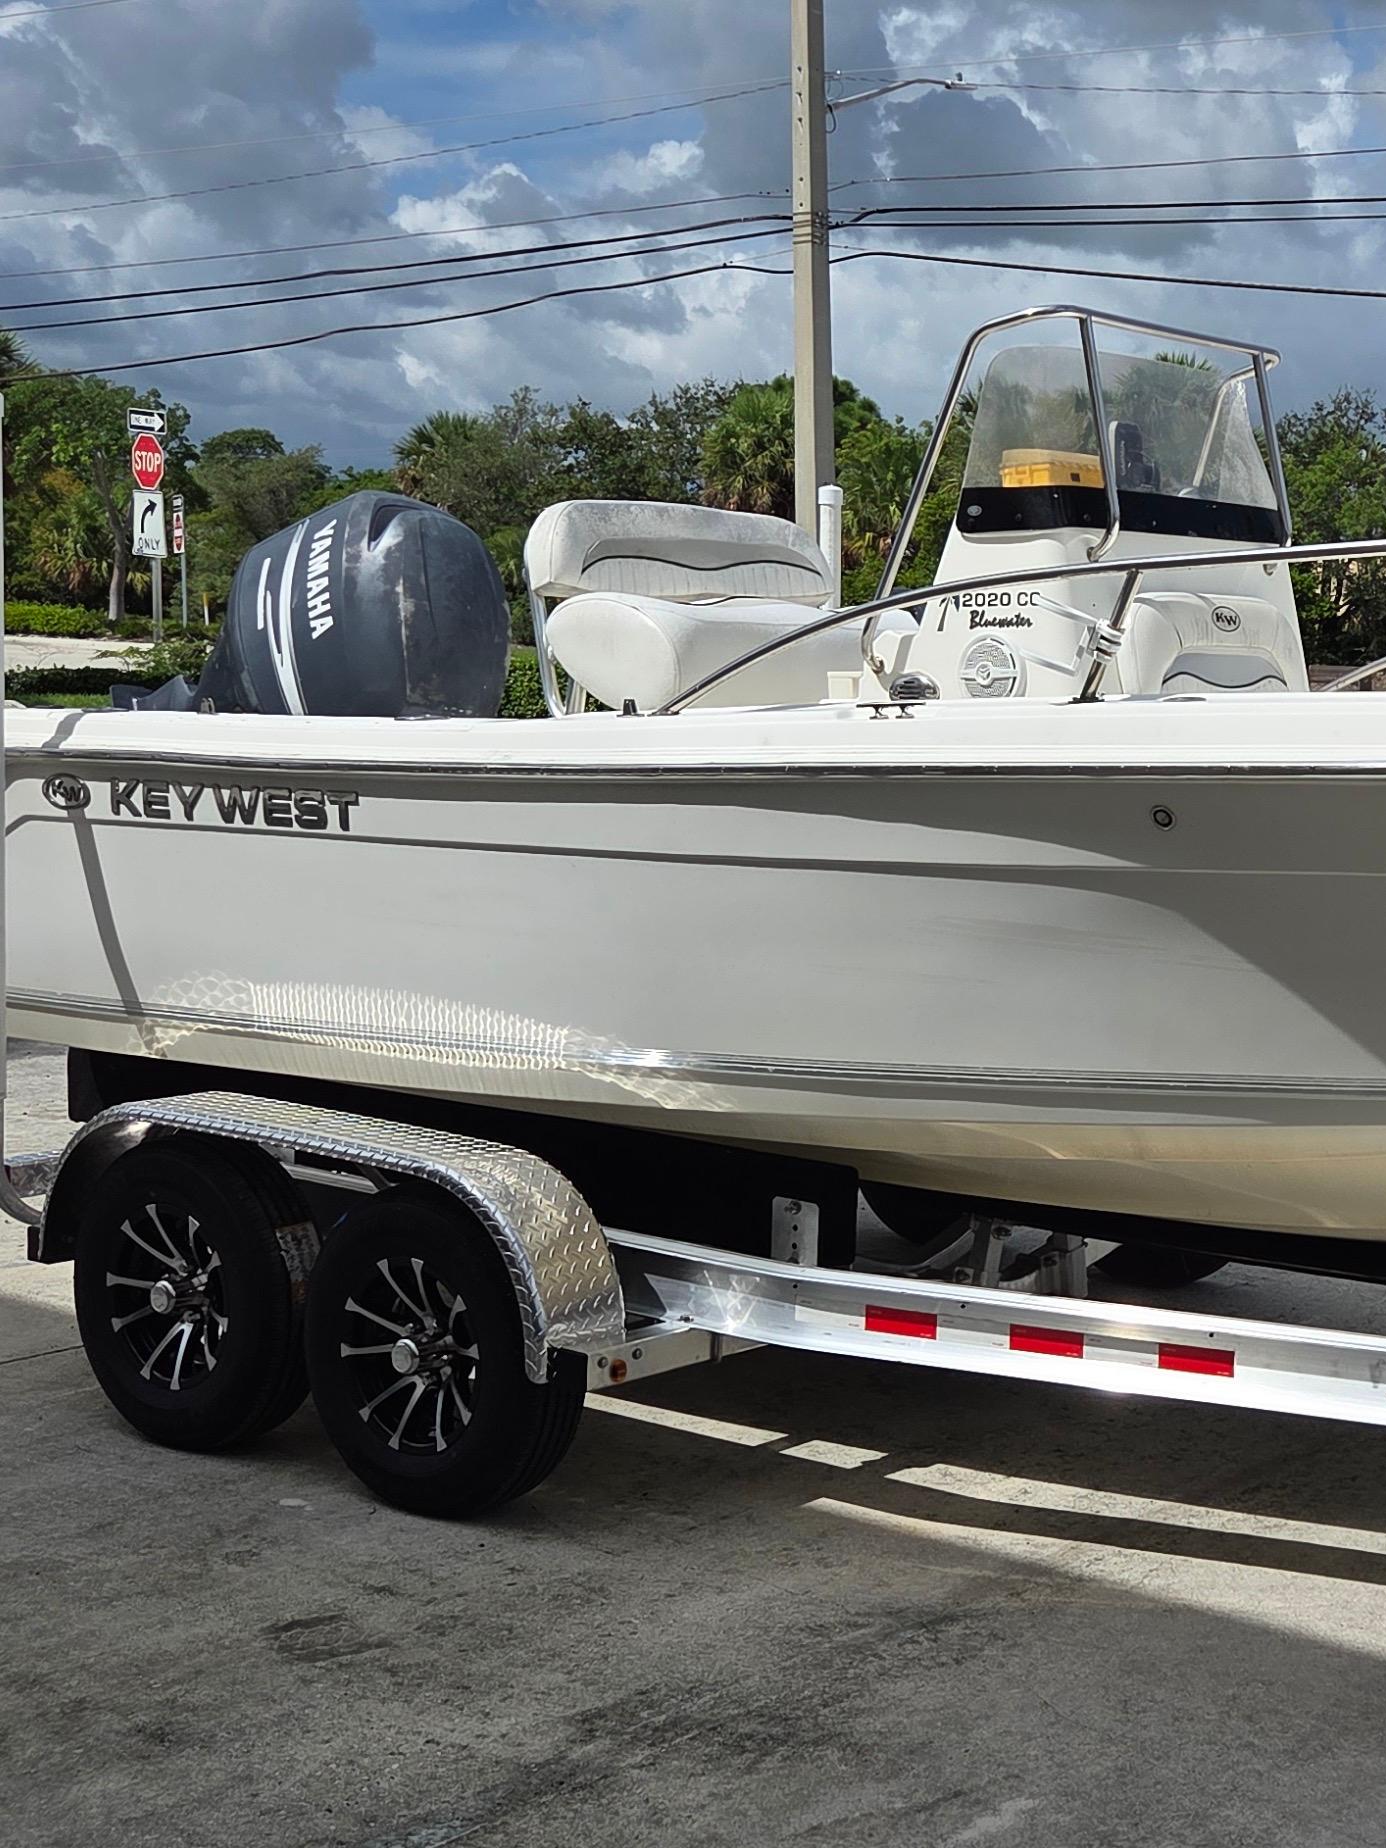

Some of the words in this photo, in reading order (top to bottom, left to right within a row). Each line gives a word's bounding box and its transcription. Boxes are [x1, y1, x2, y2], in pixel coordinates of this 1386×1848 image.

[134, 450, 161, 473] STOP
[137, 536, 160, 550] ONLY
[306, 519, 337, 640] YAMAHA
[962, 592, 1011, 607] 2020
[969, 609, 1033, 630] Bluewater
[1215, 612, 1237, 626] KW
[110, 777, 205, 822] KEY
[212, 783, 360, 832] WEST
